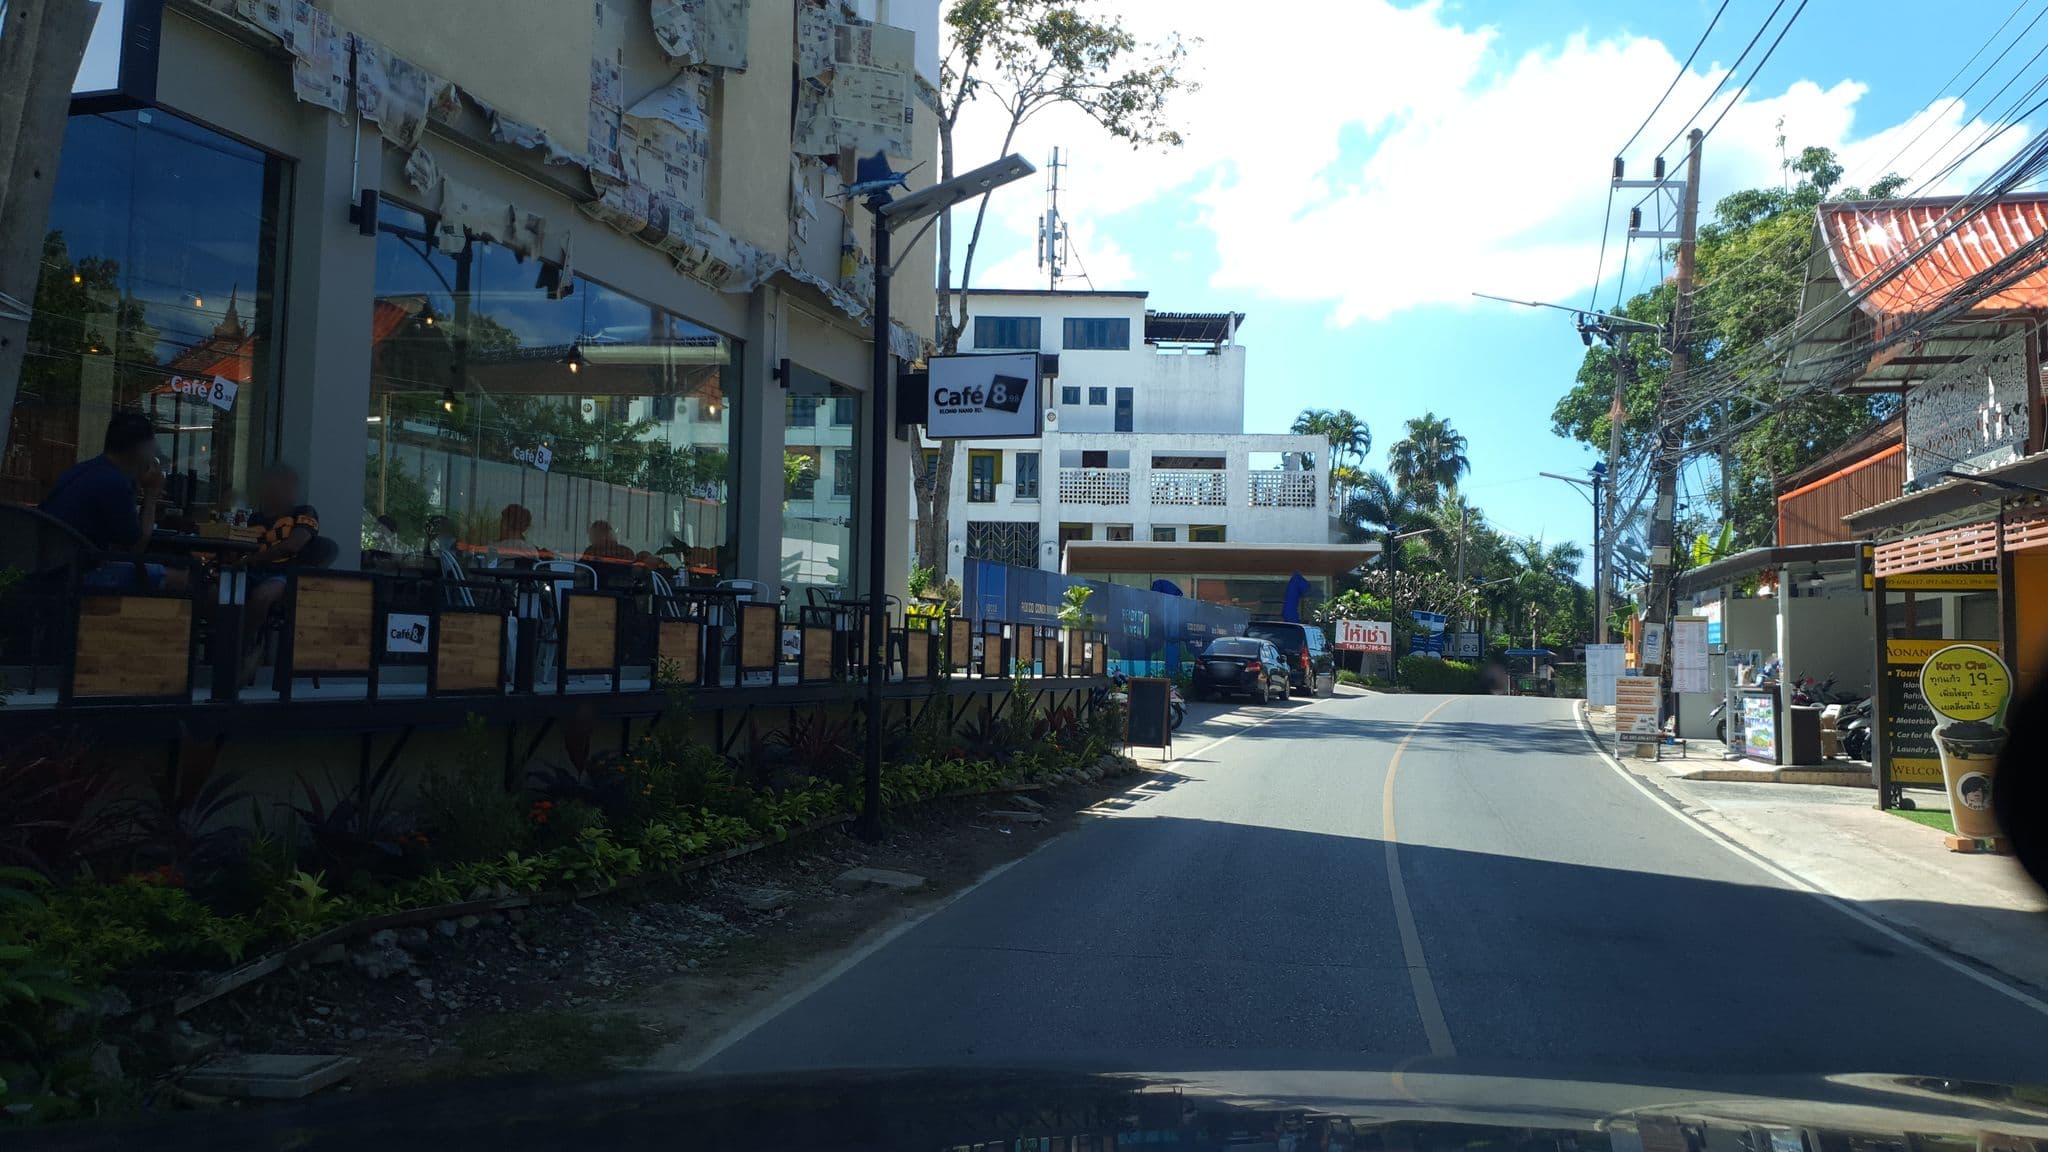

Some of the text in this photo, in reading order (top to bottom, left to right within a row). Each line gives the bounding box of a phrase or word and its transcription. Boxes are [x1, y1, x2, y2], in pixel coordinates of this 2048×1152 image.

[171, 375, 208, 398] Café
[934, 384, 984, 407] Café
[513, 447, 535, 463] Café
[1342, 620, 1388, 643] ให้เช่า
[1936, 661, 1962, 671] Koro
[1895, 668, 1920, 678] Touri
[1903, 681, 1920, 689] Islan
[1896, 745, 1929, 754] Laundry
